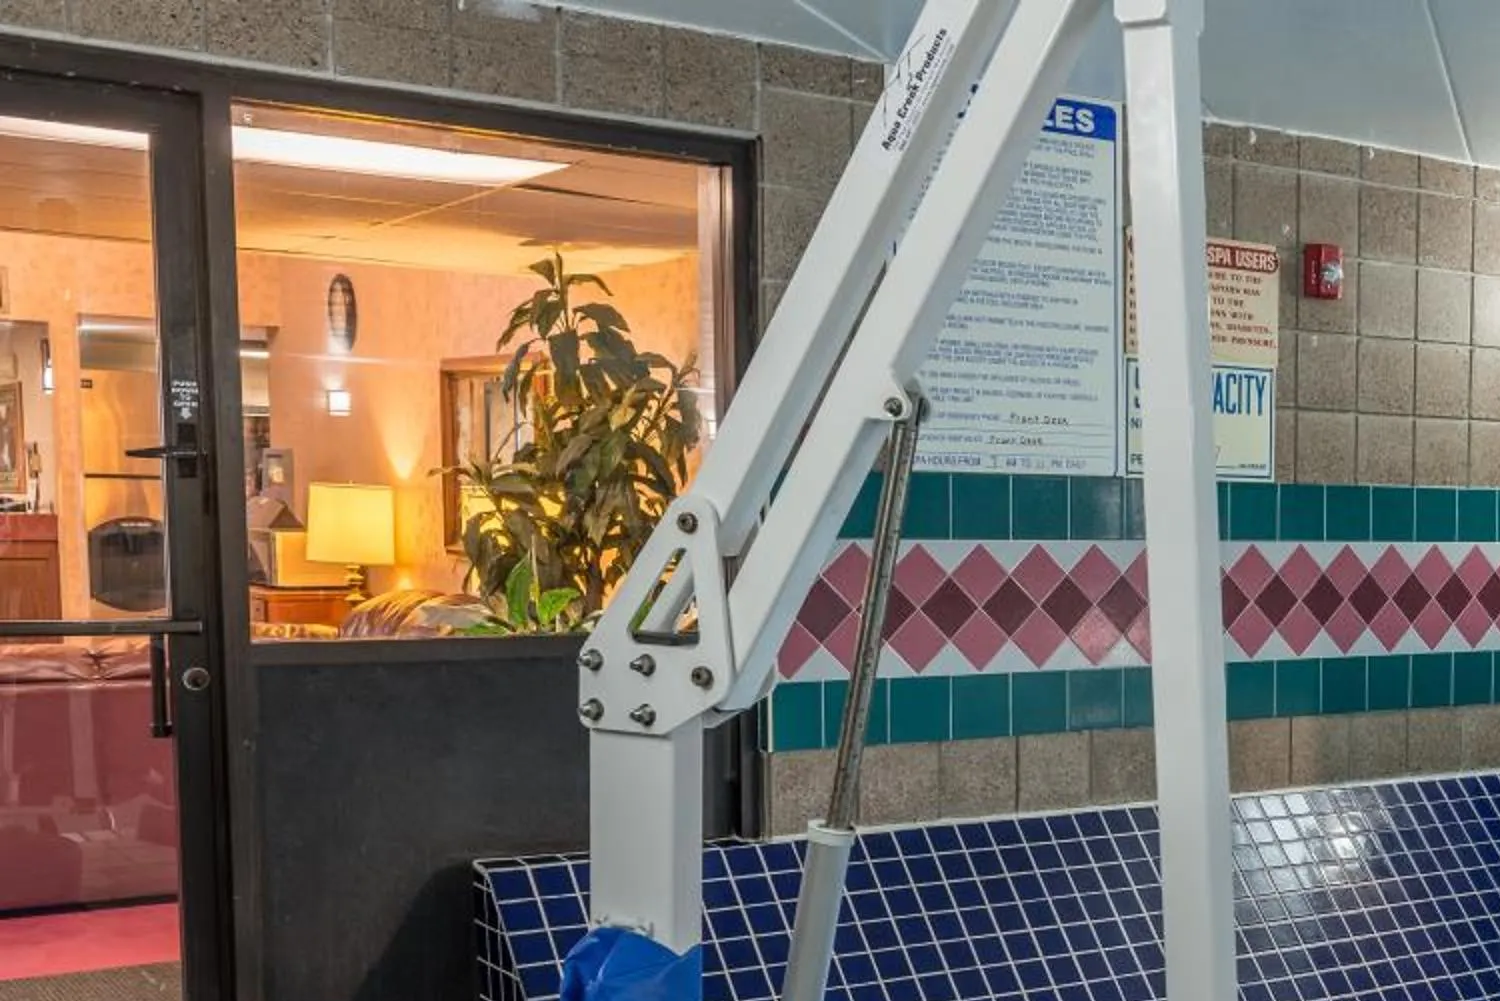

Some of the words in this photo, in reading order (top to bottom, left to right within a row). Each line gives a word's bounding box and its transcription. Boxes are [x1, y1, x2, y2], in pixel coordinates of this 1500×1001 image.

[881, 121, 901, 151] Aqua
[915, 28, 948, 82] Products
[1208, 246, 1232, 266] SPA
[1235, 250, 1276, 271] USERS
[1212, 371, 1267, 416] ACITY
